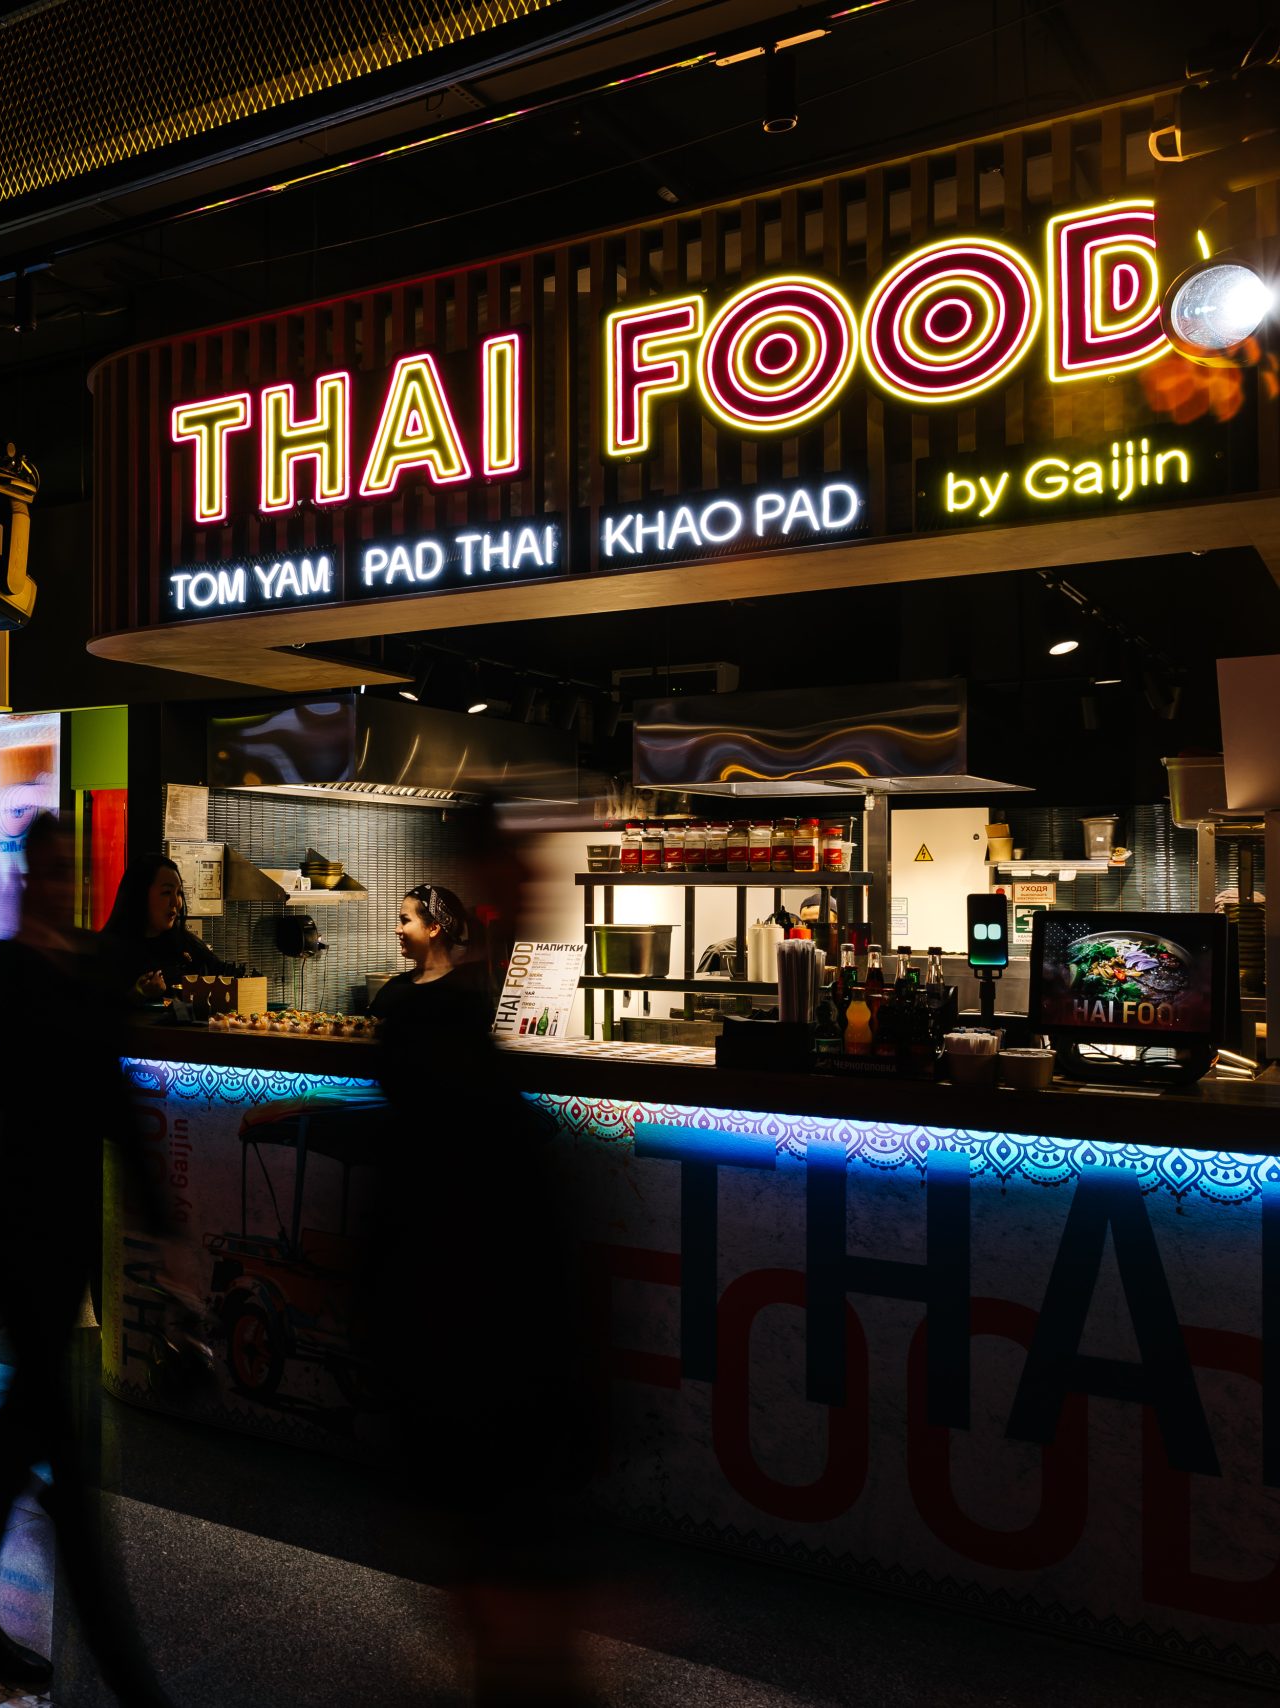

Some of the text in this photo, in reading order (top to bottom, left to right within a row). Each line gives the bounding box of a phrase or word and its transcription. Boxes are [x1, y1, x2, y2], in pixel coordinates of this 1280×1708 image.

[170, 199, 1176, 524] THAI FOOD
[945, 440, 1190, 518] by Gaijin
[603, 483, 859, 557] KHAO PAD
[171, 556, 331, 611] TOM YAM
[363, 524, 556, 587] PAD THAI
[1020, 885, 1048, 893] УХОДЯ
[535, 943, 584, 952] НАПИТКИ
[492, 943, 534, 1033] THAI FOOD
[1072, 998, 1175, 1025] HAI FOO
[170, 1118, 193, 1188] Gaijin
